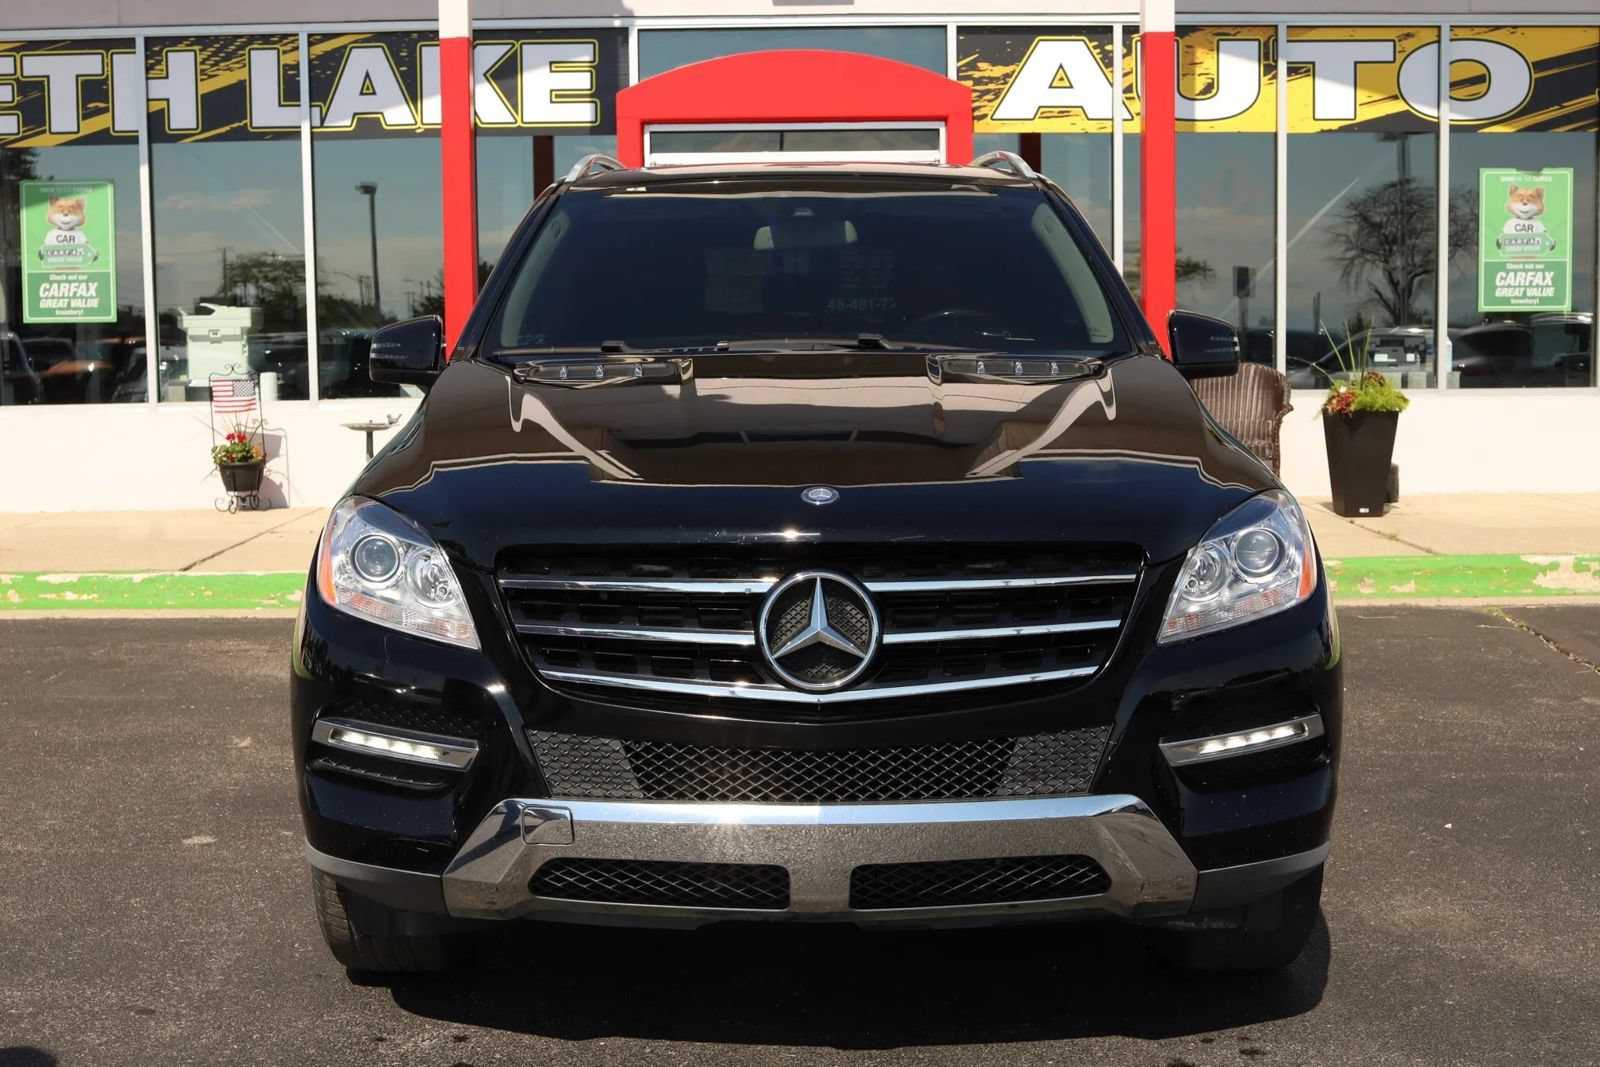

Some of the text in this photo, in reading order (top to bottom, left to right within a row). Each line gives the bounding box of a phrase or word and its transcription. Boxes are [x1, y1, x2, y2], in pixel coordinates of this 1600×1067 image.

[0, 36, 1534, 136] TH LAKE AUTO
[1514, 223, 1534, 233] CAR
[56, 234, 76, 243] CAR
[1496, 271, 1554, 286] CARFAX
[40, 282, 98, 297] CARFAX
[1495, 287, 1555, 297] GREAT VALUE
[39, 297, 100, 309] GREAT VALUE
